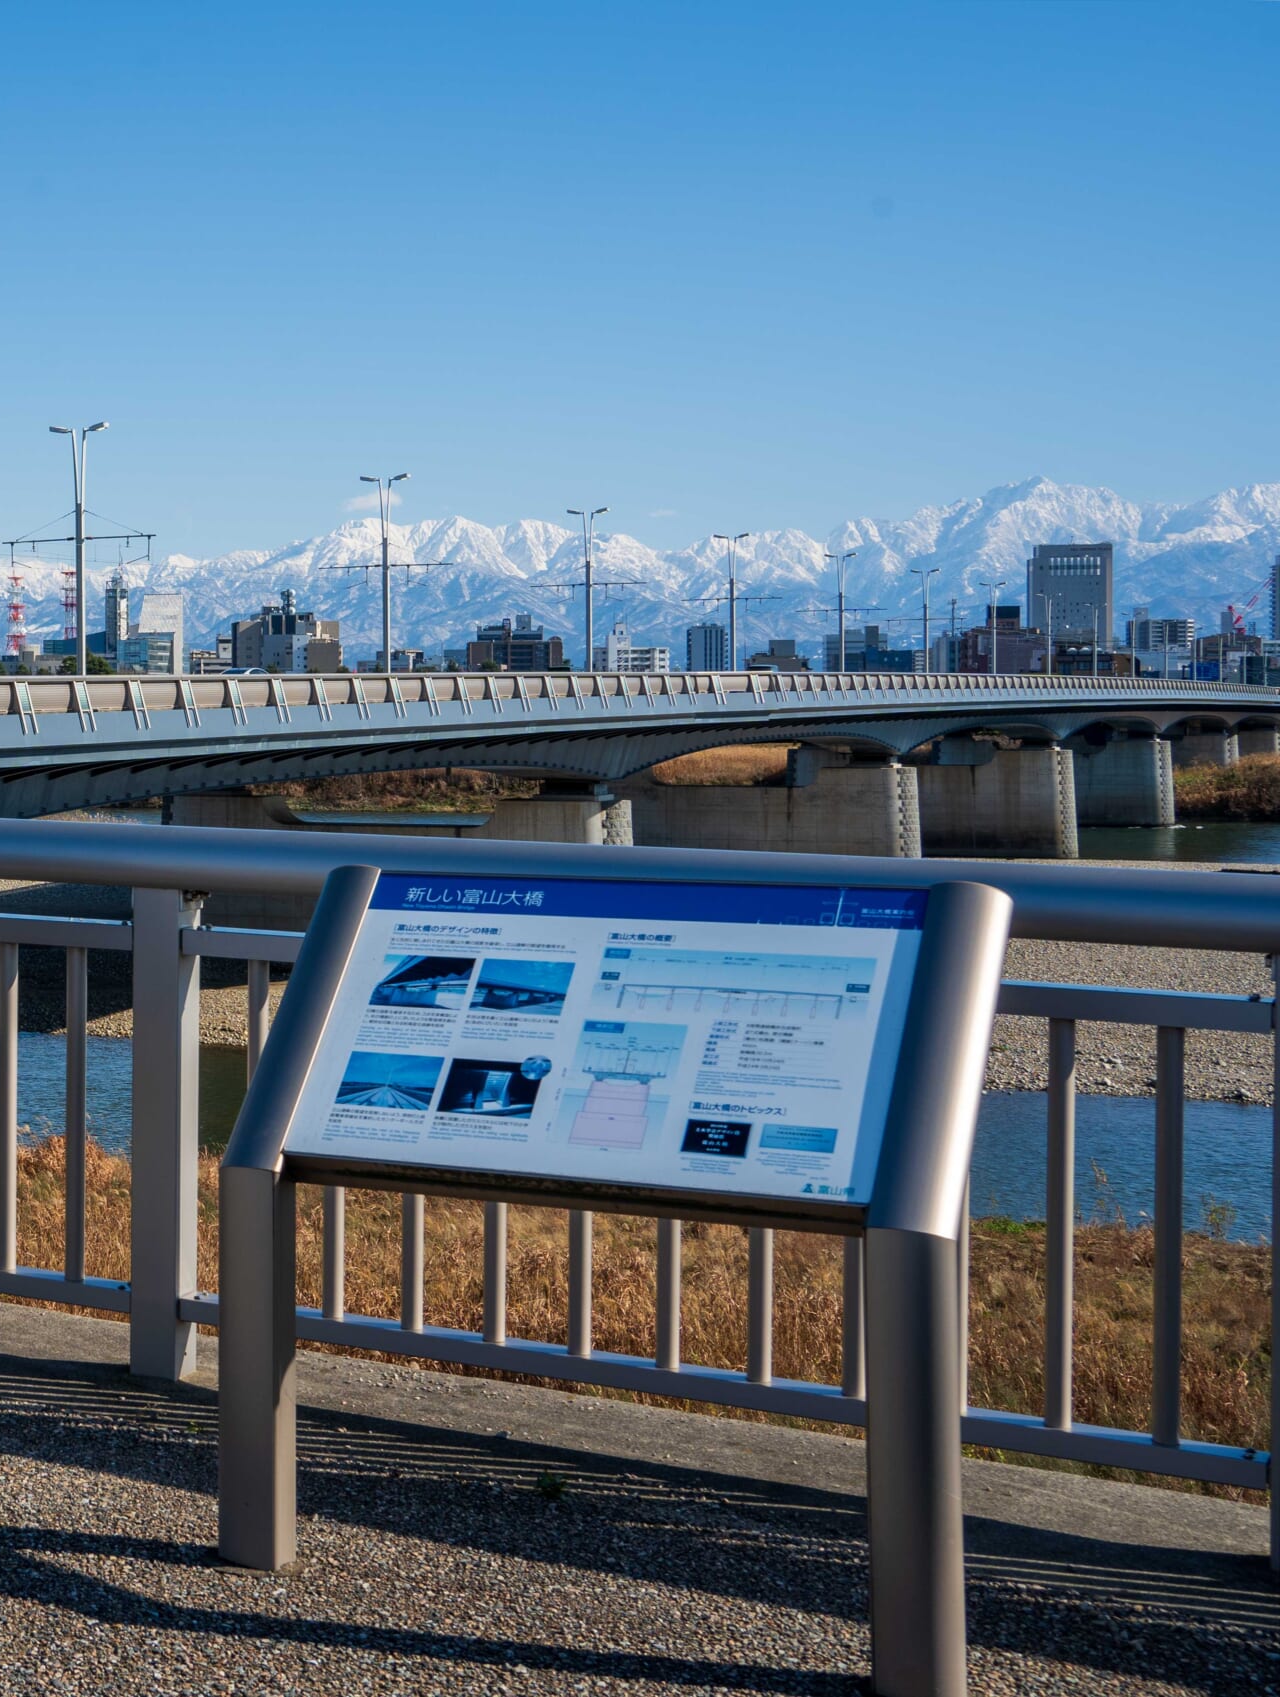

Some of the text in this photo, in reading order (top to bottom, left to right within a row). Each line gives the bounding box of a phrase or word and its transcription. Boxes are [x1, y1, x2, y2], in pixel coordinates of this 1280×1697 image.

[405, 887, 545, 907] 新しい富山大橋
